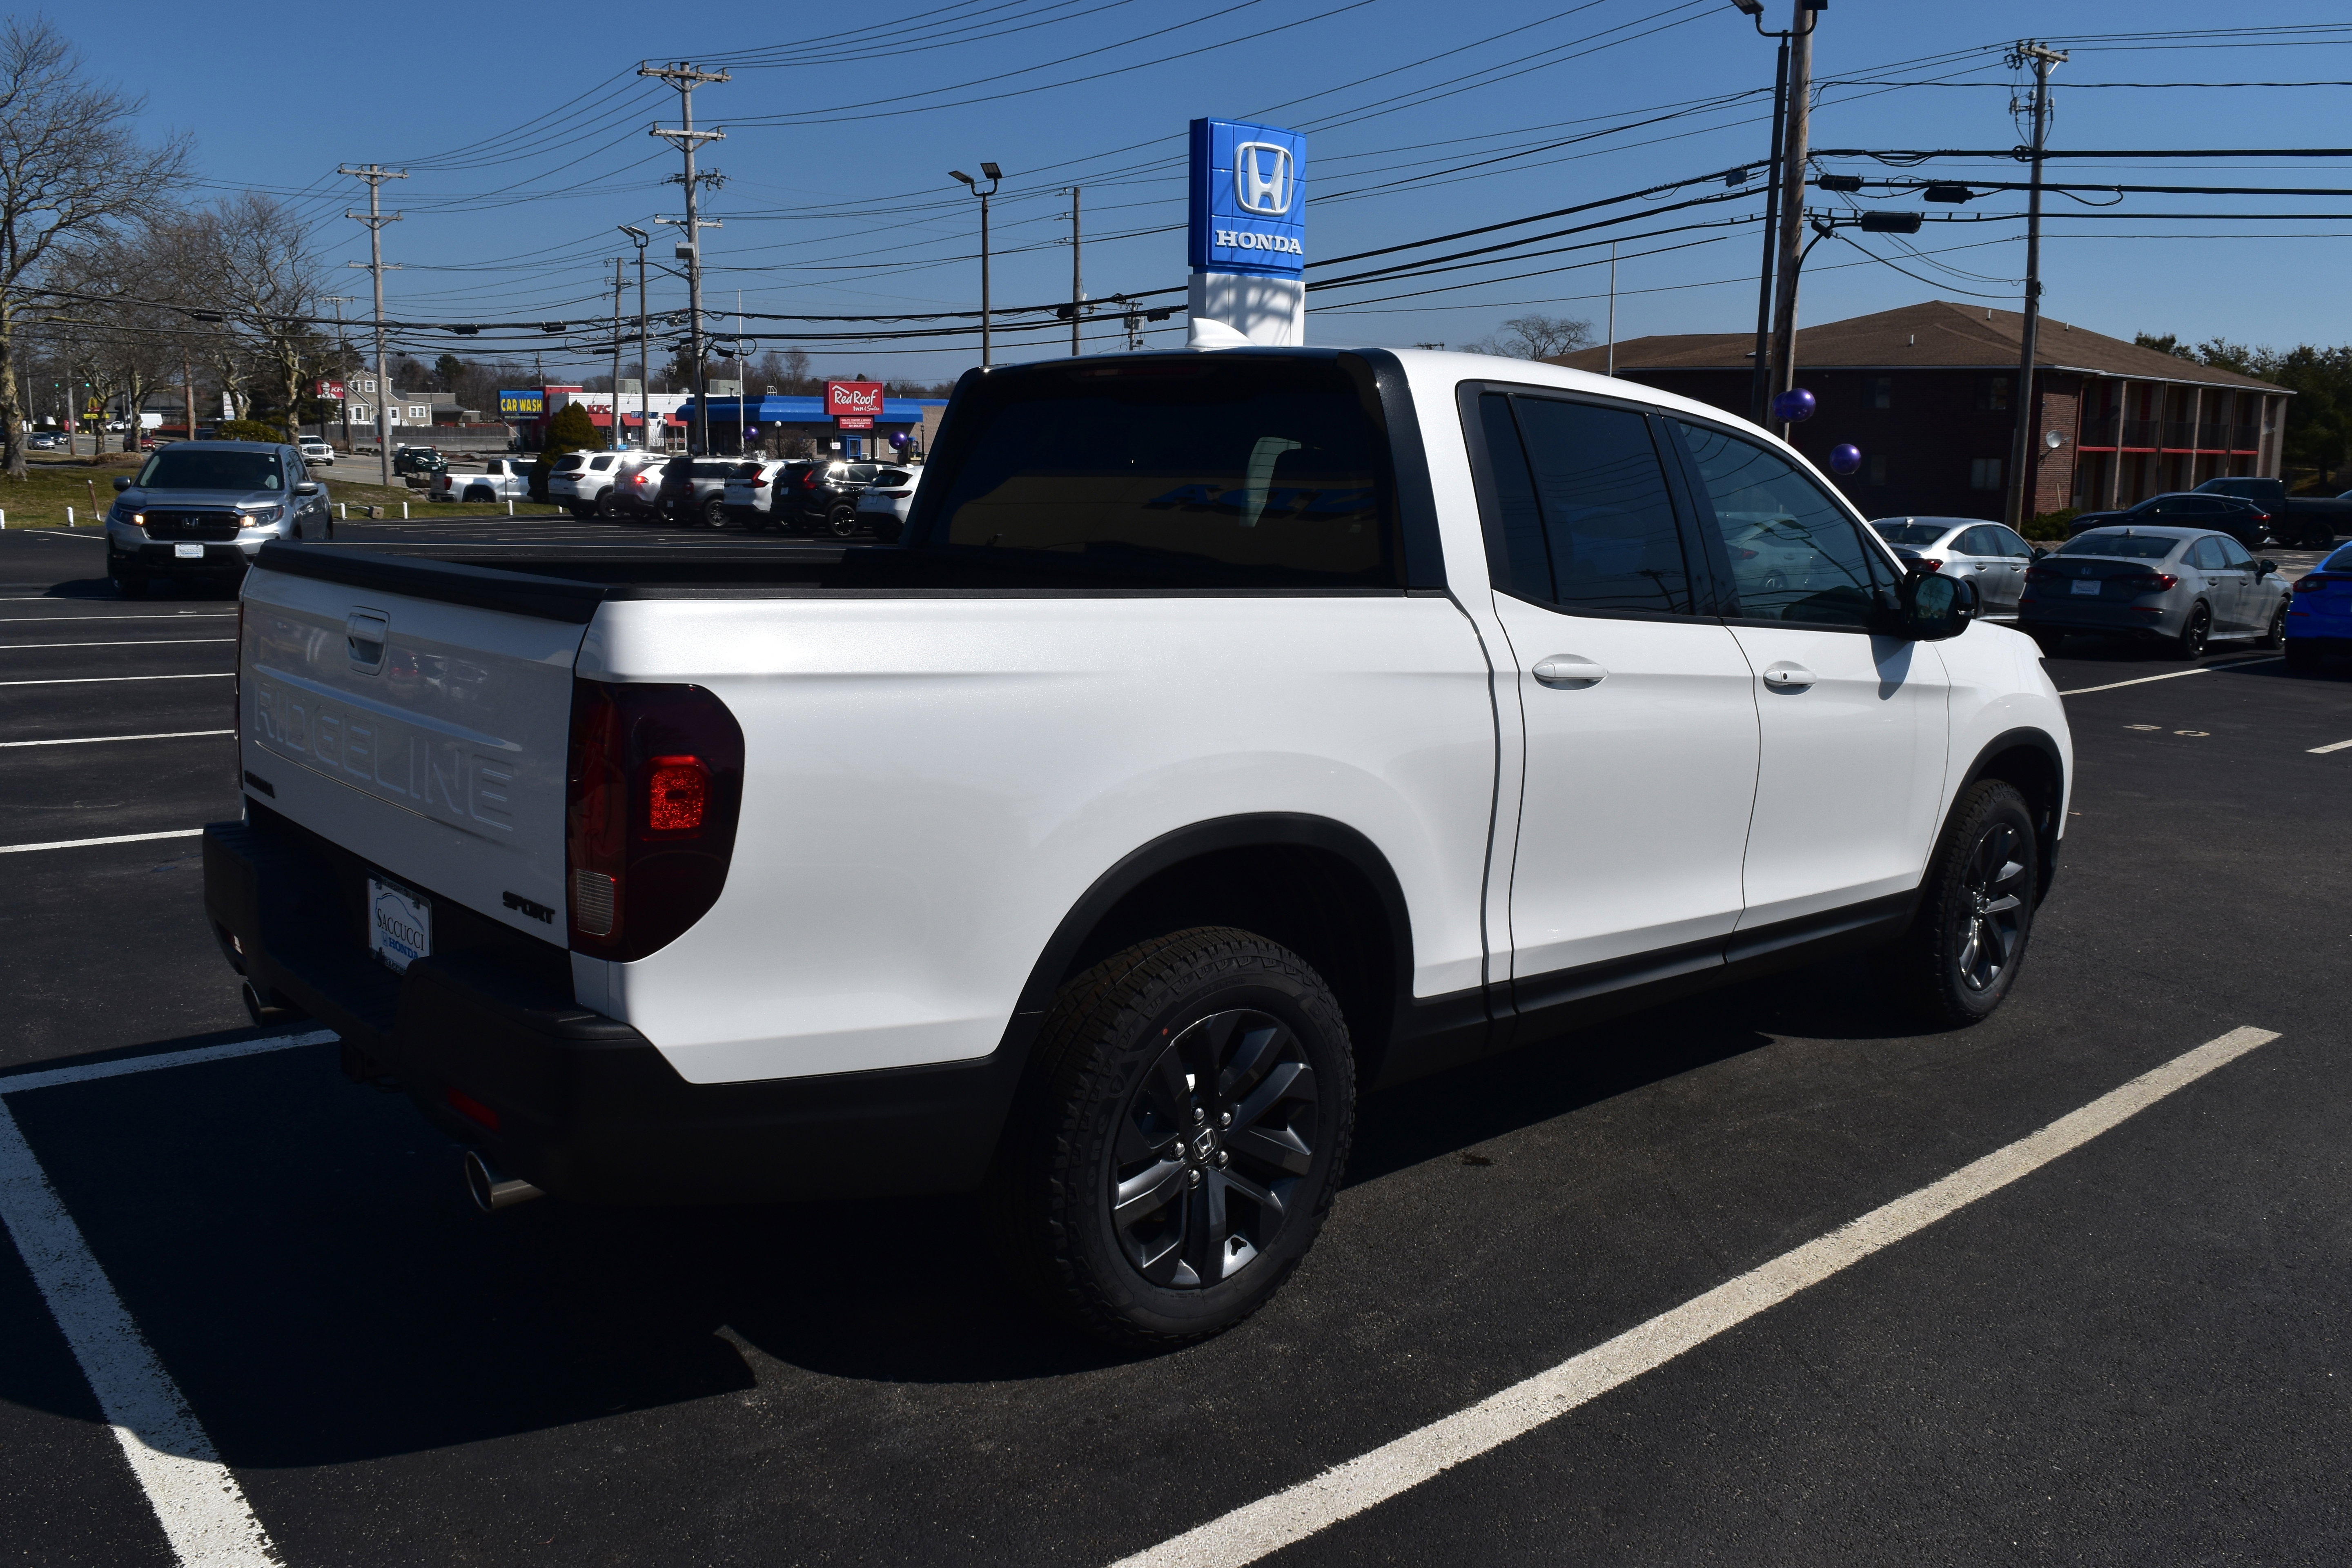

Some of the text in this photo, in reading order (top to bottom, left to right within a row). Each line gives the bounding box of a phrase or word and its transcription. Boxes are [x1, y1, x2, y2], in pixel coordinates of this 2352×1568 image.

[1215, 229, 1303, 254] HONDA
[501, 399, 542, 412] CAR WASH
[587, 404, 612, 413] KFC
[834, 389, 878, 405] Red Roof
[253, 680, 514, 832] RIDGELINE
[502, 891, 555, 924] SPORT
[377, 908, 425, 951] SACCUCCI
[388, 936, 419, 959] HONDA
